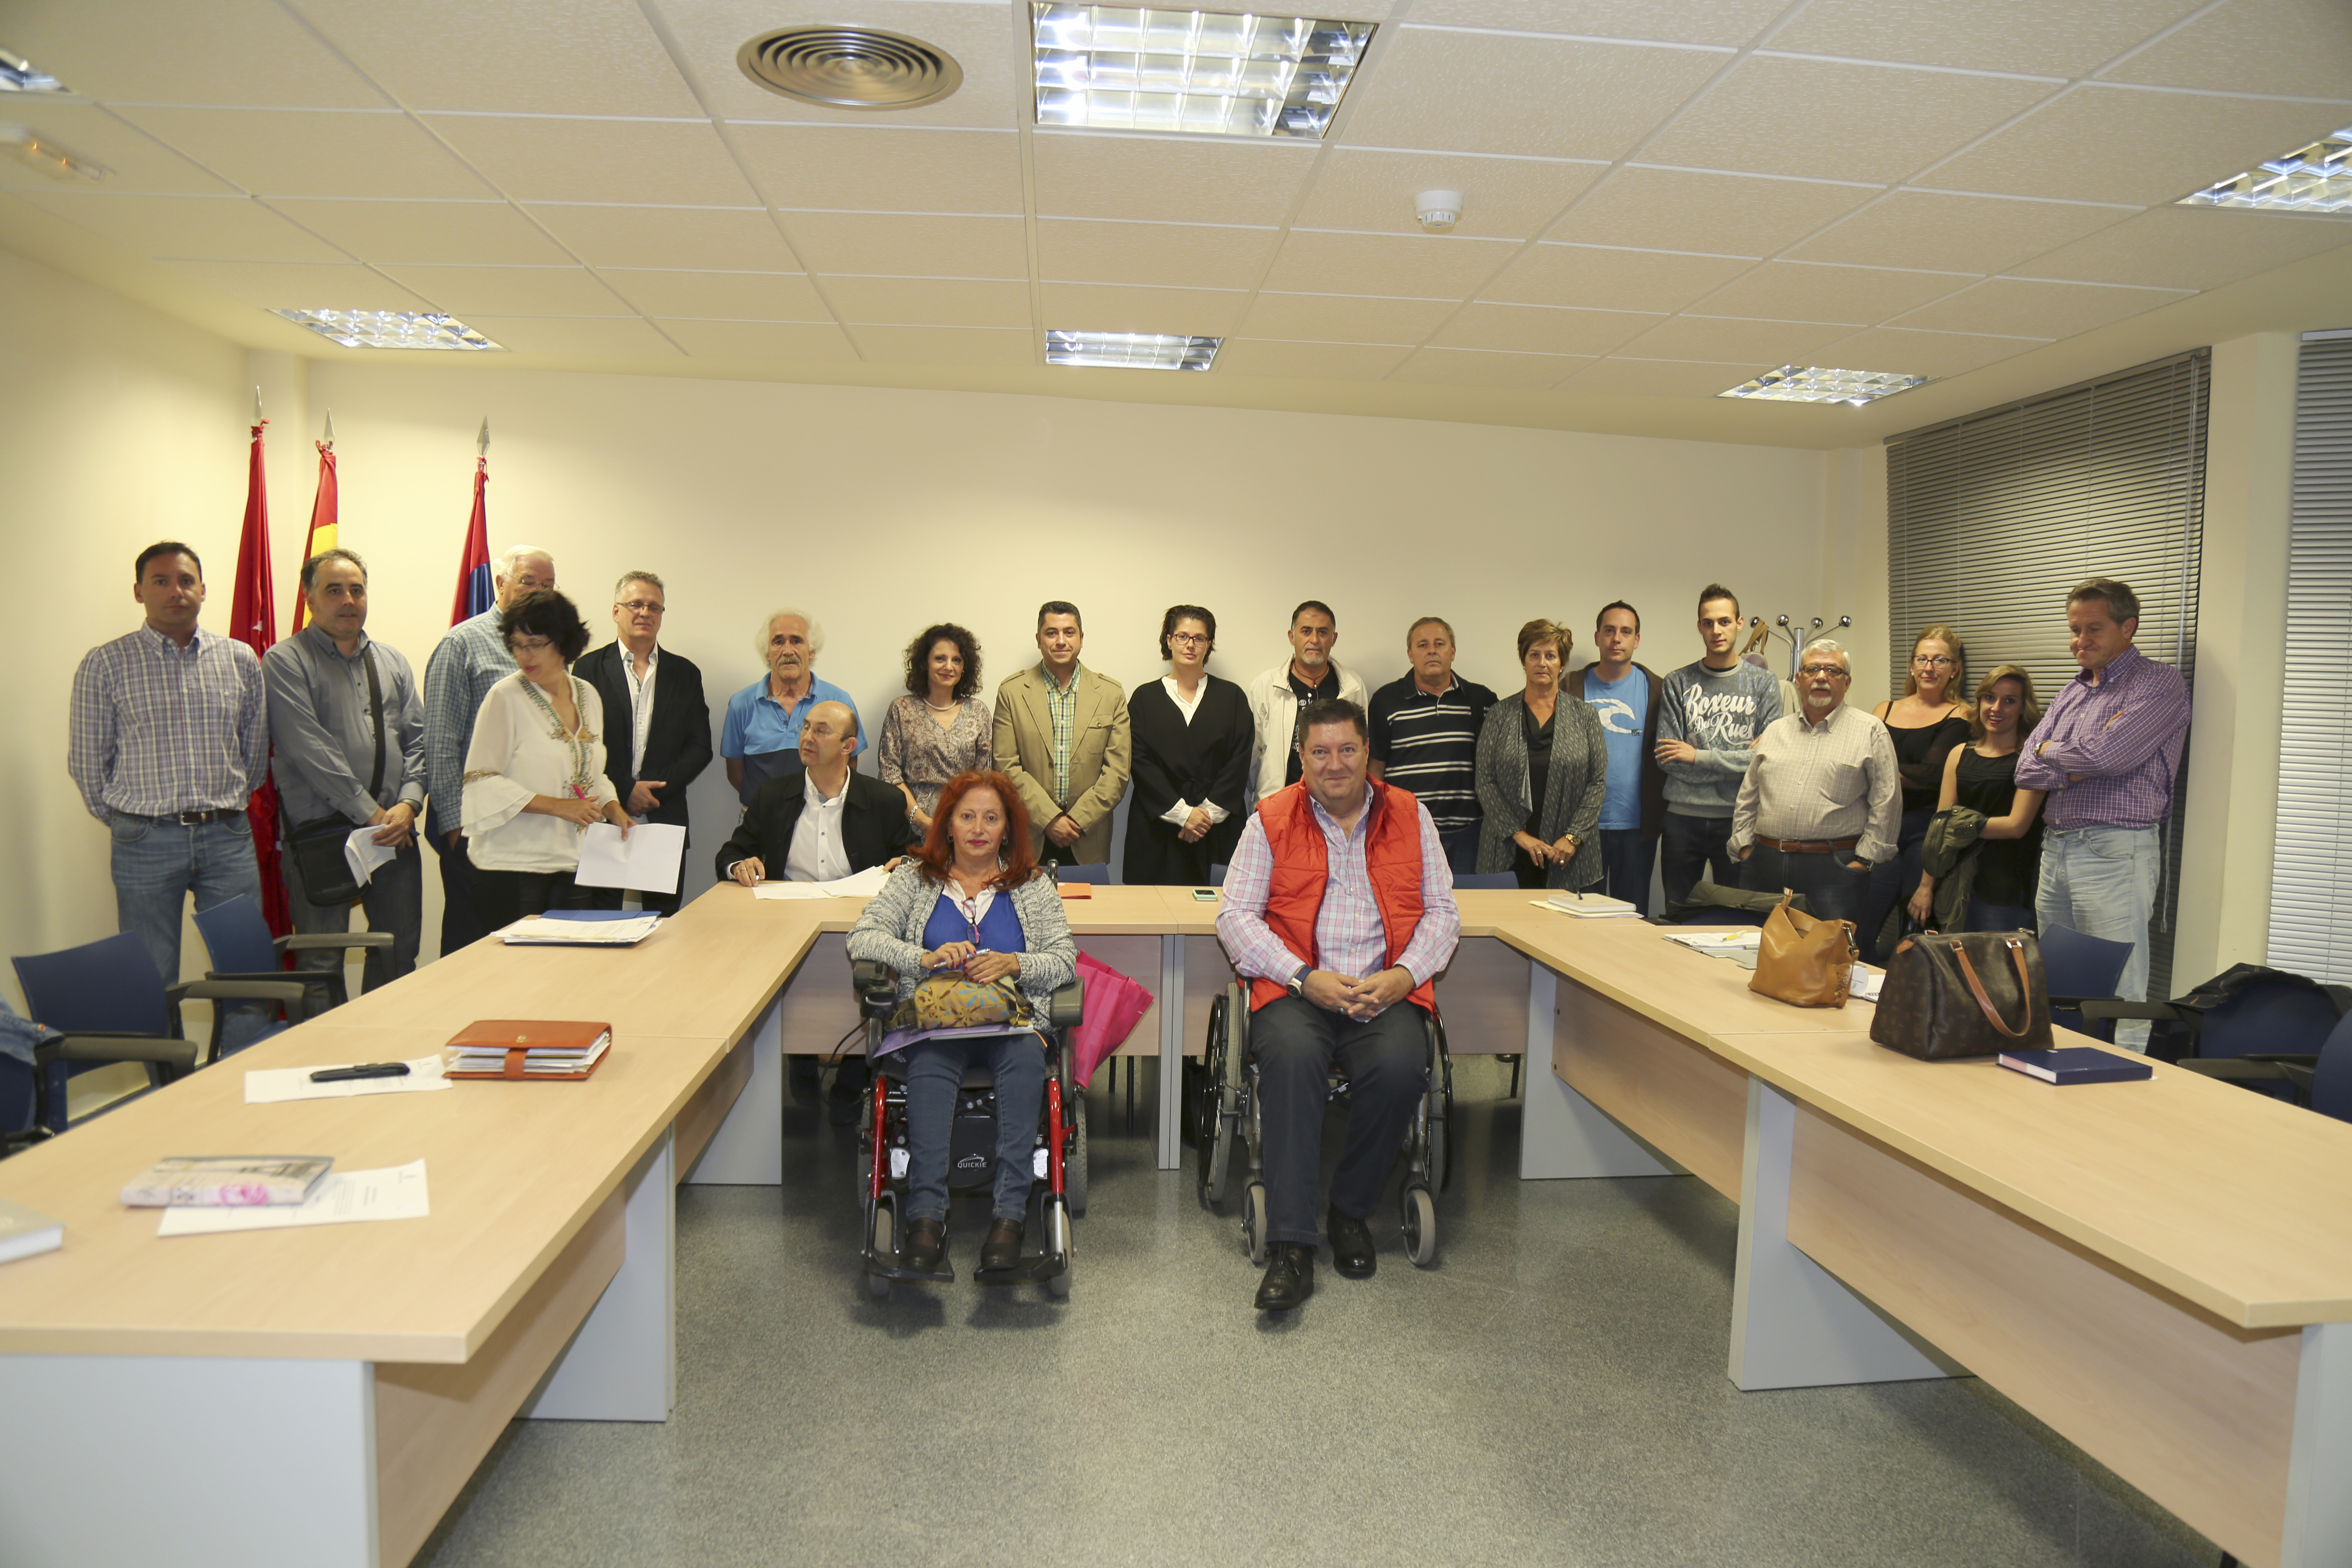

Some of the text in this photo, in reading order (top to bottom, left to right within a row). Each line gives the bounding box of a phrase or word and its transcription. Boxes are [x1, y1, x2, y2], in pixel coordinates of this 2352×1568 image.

[1683, 683, 1757, 727] Boxeur
[1694, 711, 1755, 745] Des Rues
